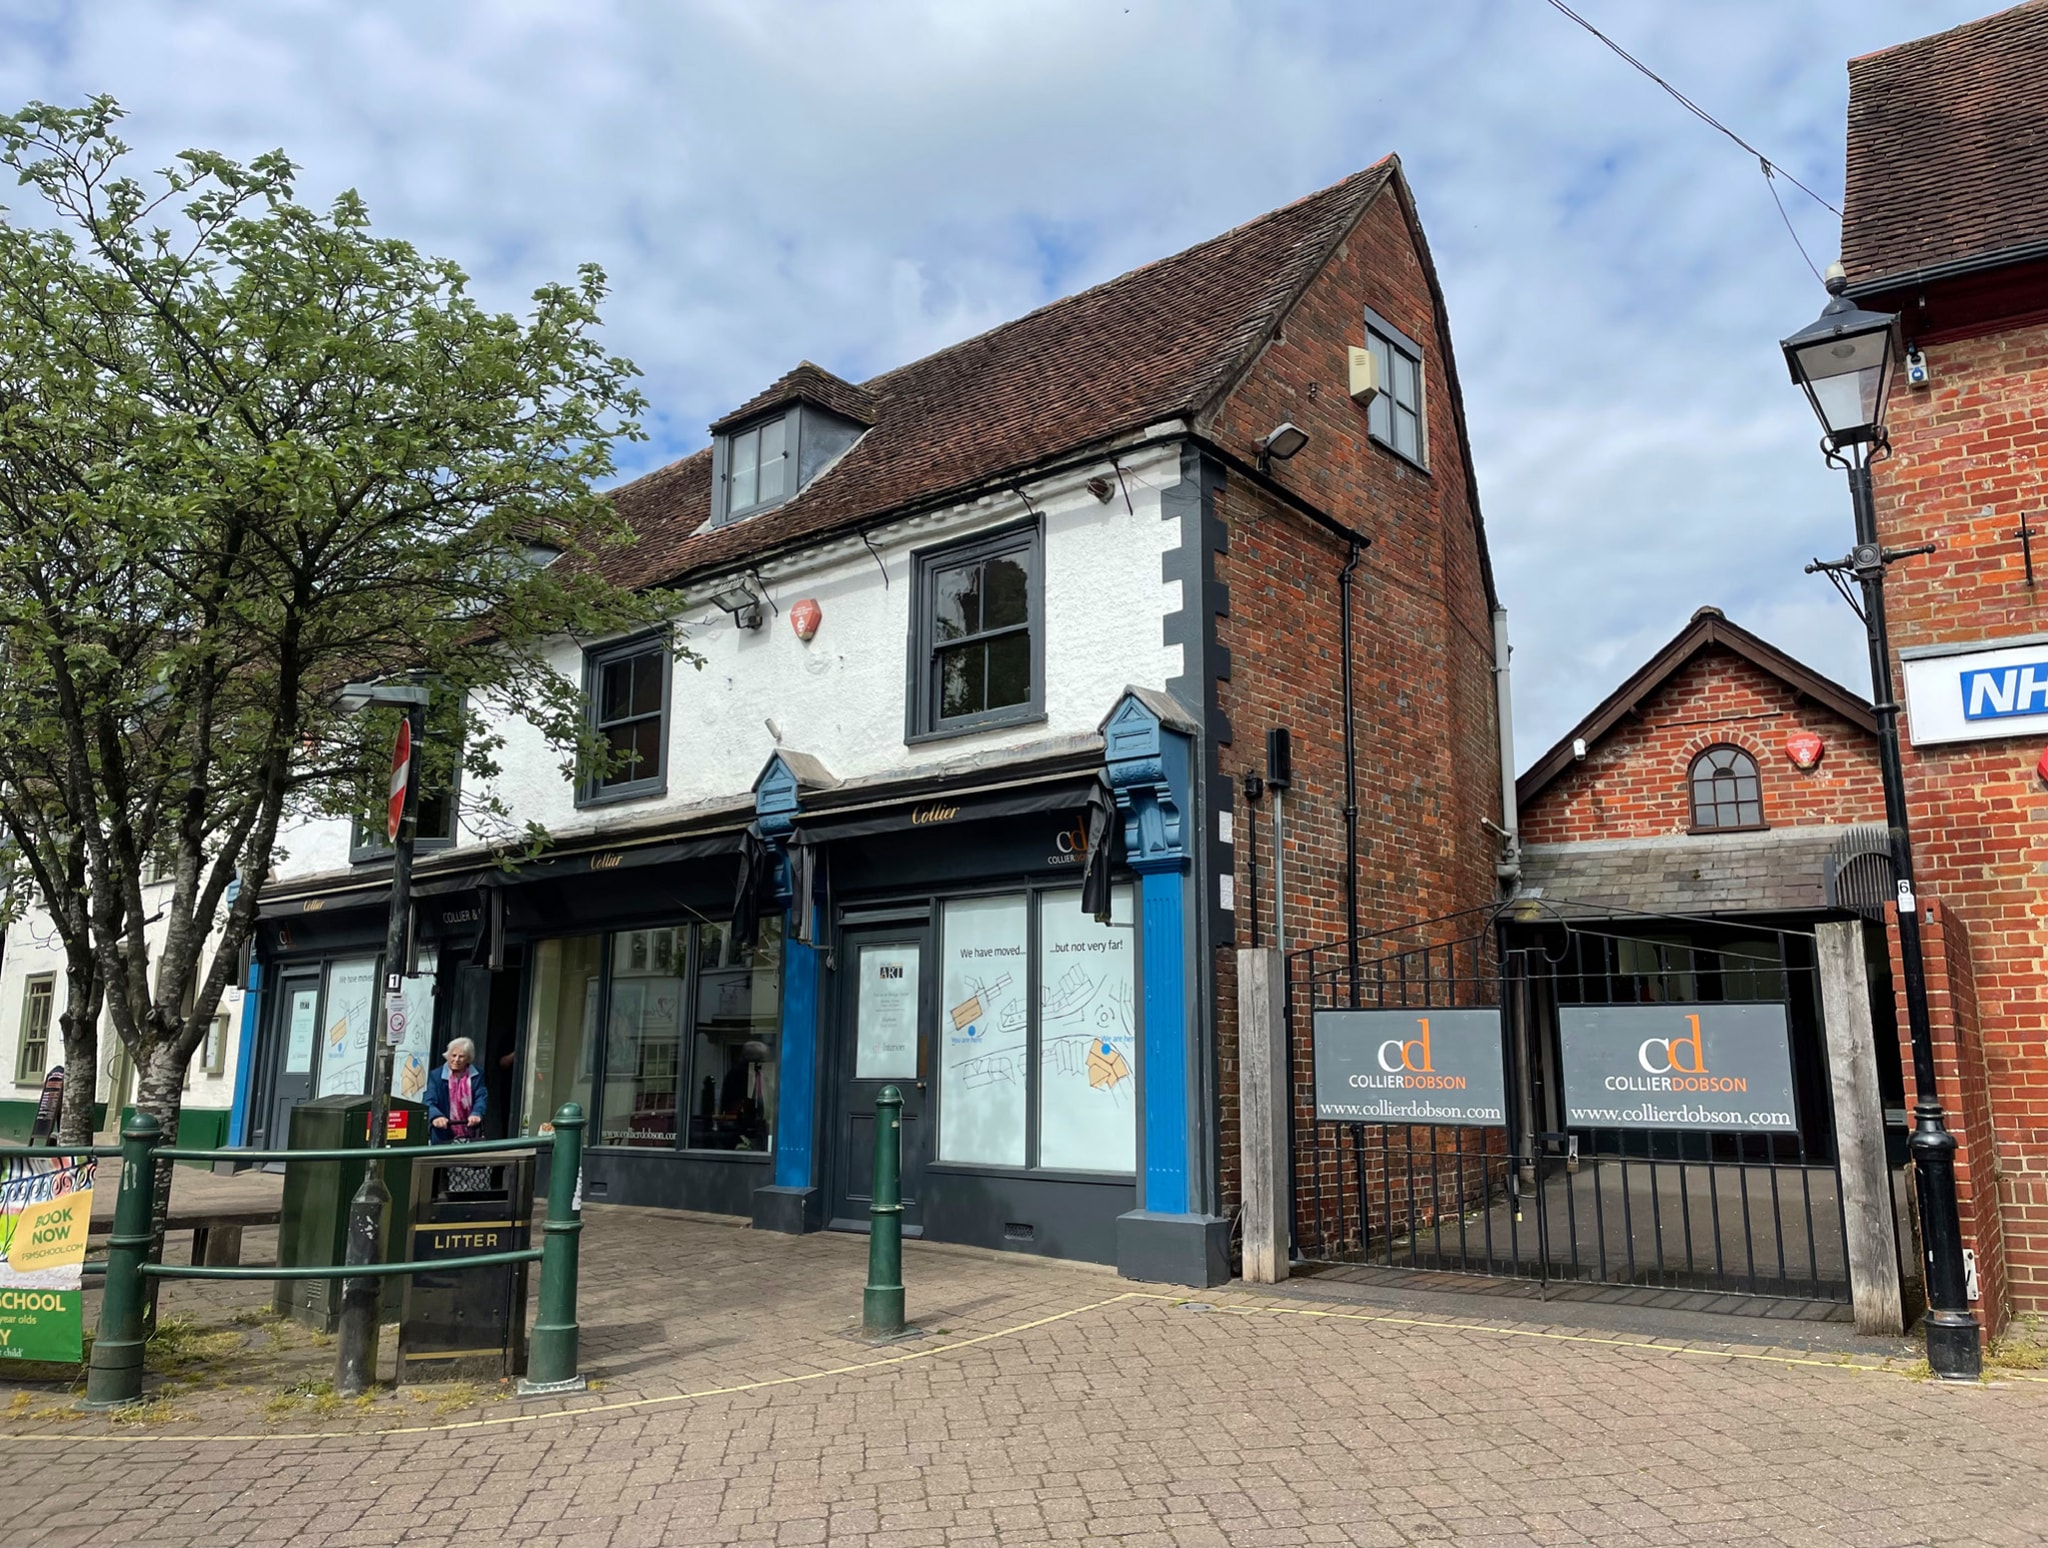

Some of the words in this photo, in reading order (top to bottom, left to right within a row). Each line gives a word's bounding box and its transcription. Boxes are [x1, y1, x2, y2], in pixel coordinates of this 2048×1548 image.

[911, 801, 960, 825] Collier
[591, 852, 623, 870] Collier
[1899, 881, 1909, 894] 6
[443, 909, 471, 924] COLLIER
[960, 948, 973, 959] We
[974, 948, 993, 957] have
[1071, 942, 1086, 953] not
[1087, 941, 1106, 953] very
[1107, 939, 1123, 951] far!
[391, 976, 398, 987] 1
[1377, 1017, 1436, 1073] cd
[1638, 1013, 1709, 1074] cd
[1349, 1074, 1466, 1090] COLLIERDOBSON
[1604, 1076, 1747, 1092] COLLIERDOBSON
[1320, 1099, 1501, 1119] www.collierdobson.com
[1570, 1103, 1791, 1125] www.collierdobson.com
[34, 1207, 73, 1229] BOOK
[32, 1225, 71, 1246] NOW
[434, 1233, 498, 1249] LITTER
[0, 1292, 66, 1312] CHOOL
[18, 1314, 37, 1325] olds
